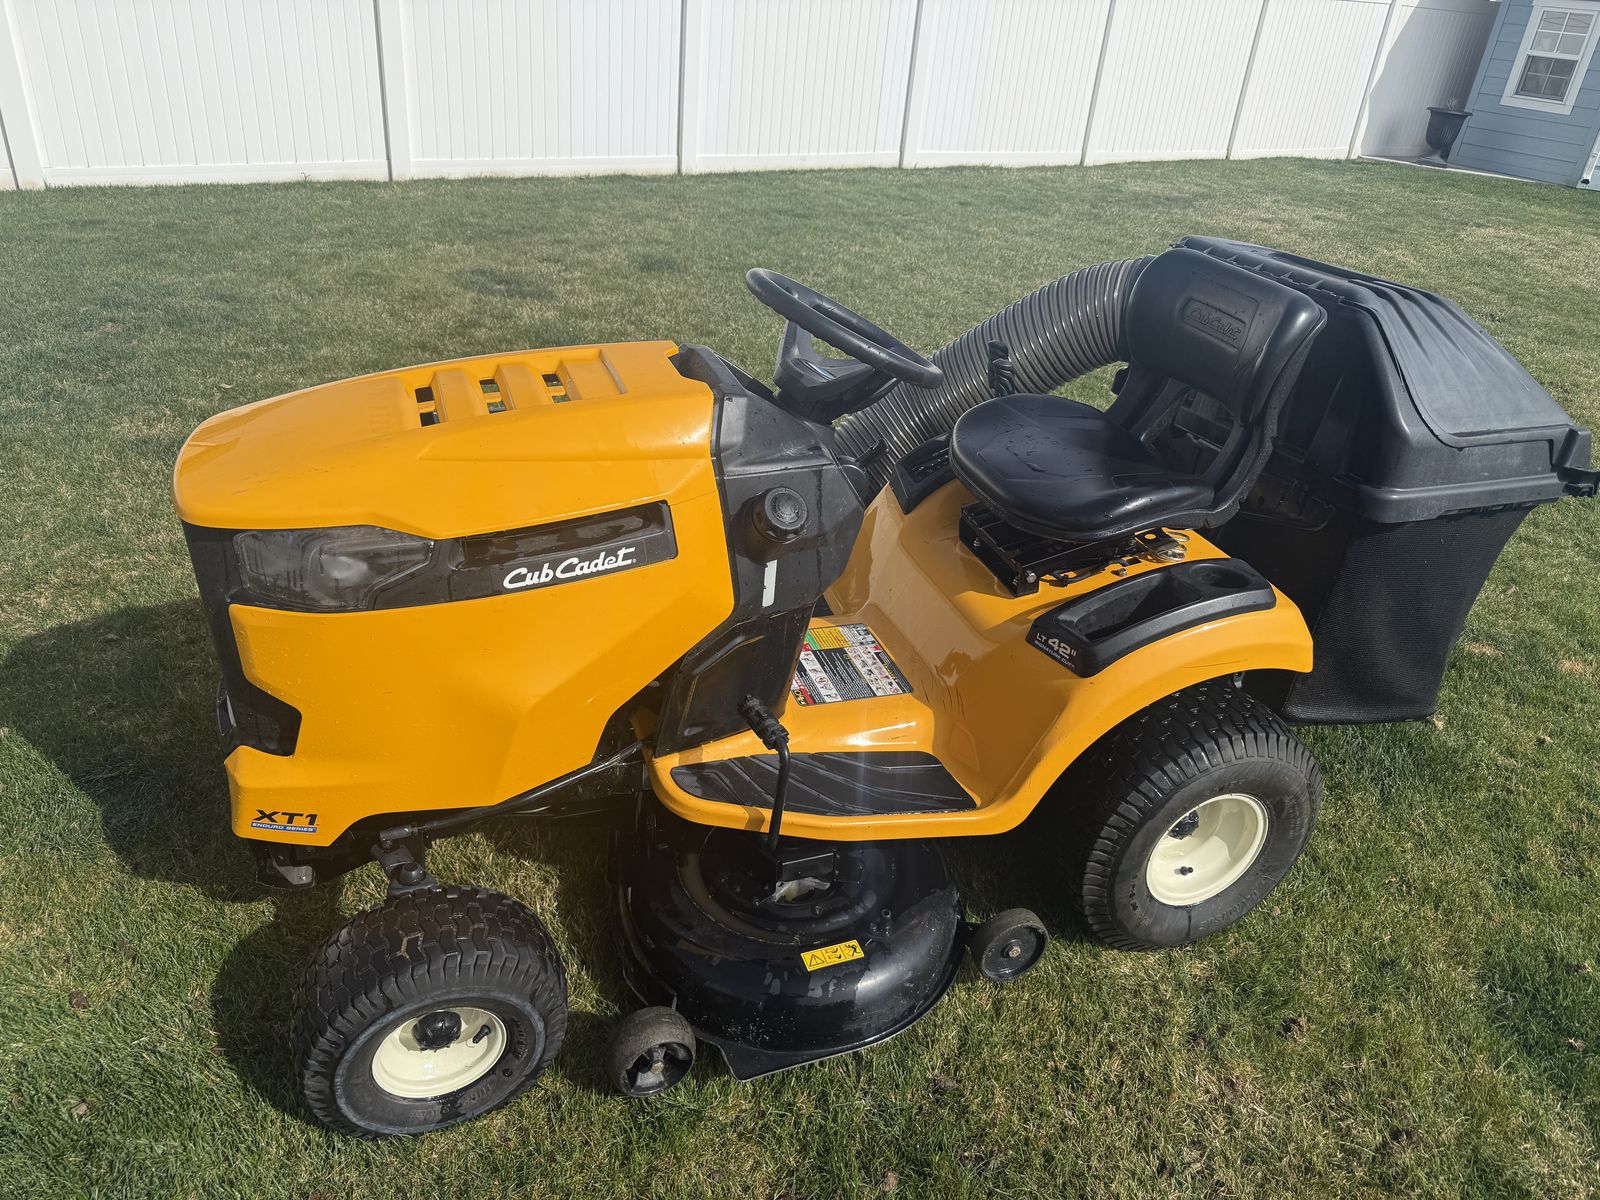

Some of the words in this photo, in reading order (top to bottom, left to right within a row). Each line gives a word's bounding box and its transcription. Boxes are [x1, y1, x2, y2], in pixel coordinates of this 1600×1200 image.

[503, 562, 554, 589] Cub
[555, 547, 636, 579] Cadet
[1036, 632, 1047, 642] LT
[1034, 640, 1061, 660] SIGNATURE
[252, 809, 318, 826] XT1
[252, 822, 284, 830] ENDURO
